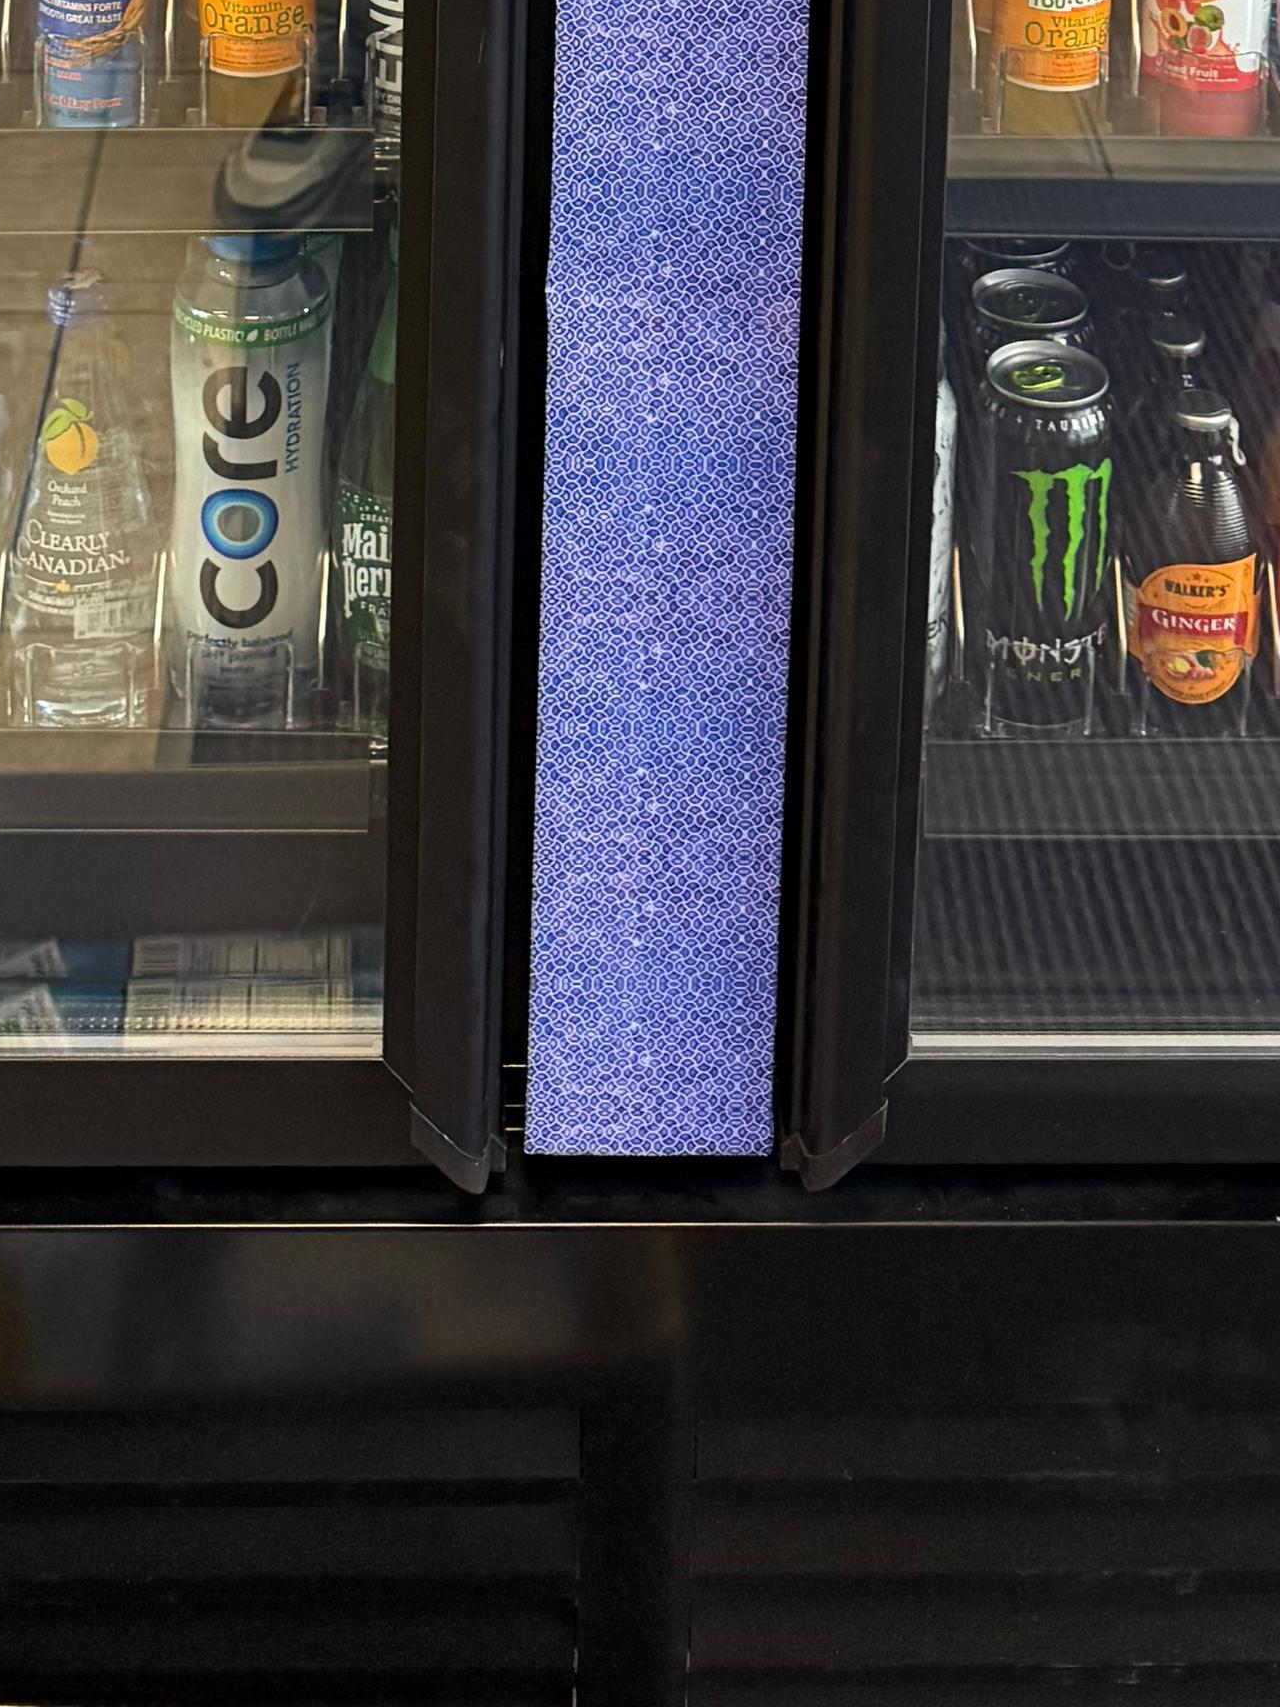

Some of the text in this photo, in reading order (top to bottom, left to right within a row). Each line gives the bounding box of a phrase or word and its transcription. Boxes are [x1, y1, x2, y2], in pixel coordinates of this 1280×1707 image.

[205, 3, 304, 36] Orange
[221, 0, 282, 15] Vitamin
[1025, 20, 1108, 48] Orang
[285, 362, 302, 475] HYDRATION
[199, 365, 282, 630] core
[27, 519, 110, 555] CLEARLY
[17, 536, 126, 576] CANADIAN
[1164, 579, 1231, 597] WALKER'S
[1152, 608, 1238, 632] GINGER
